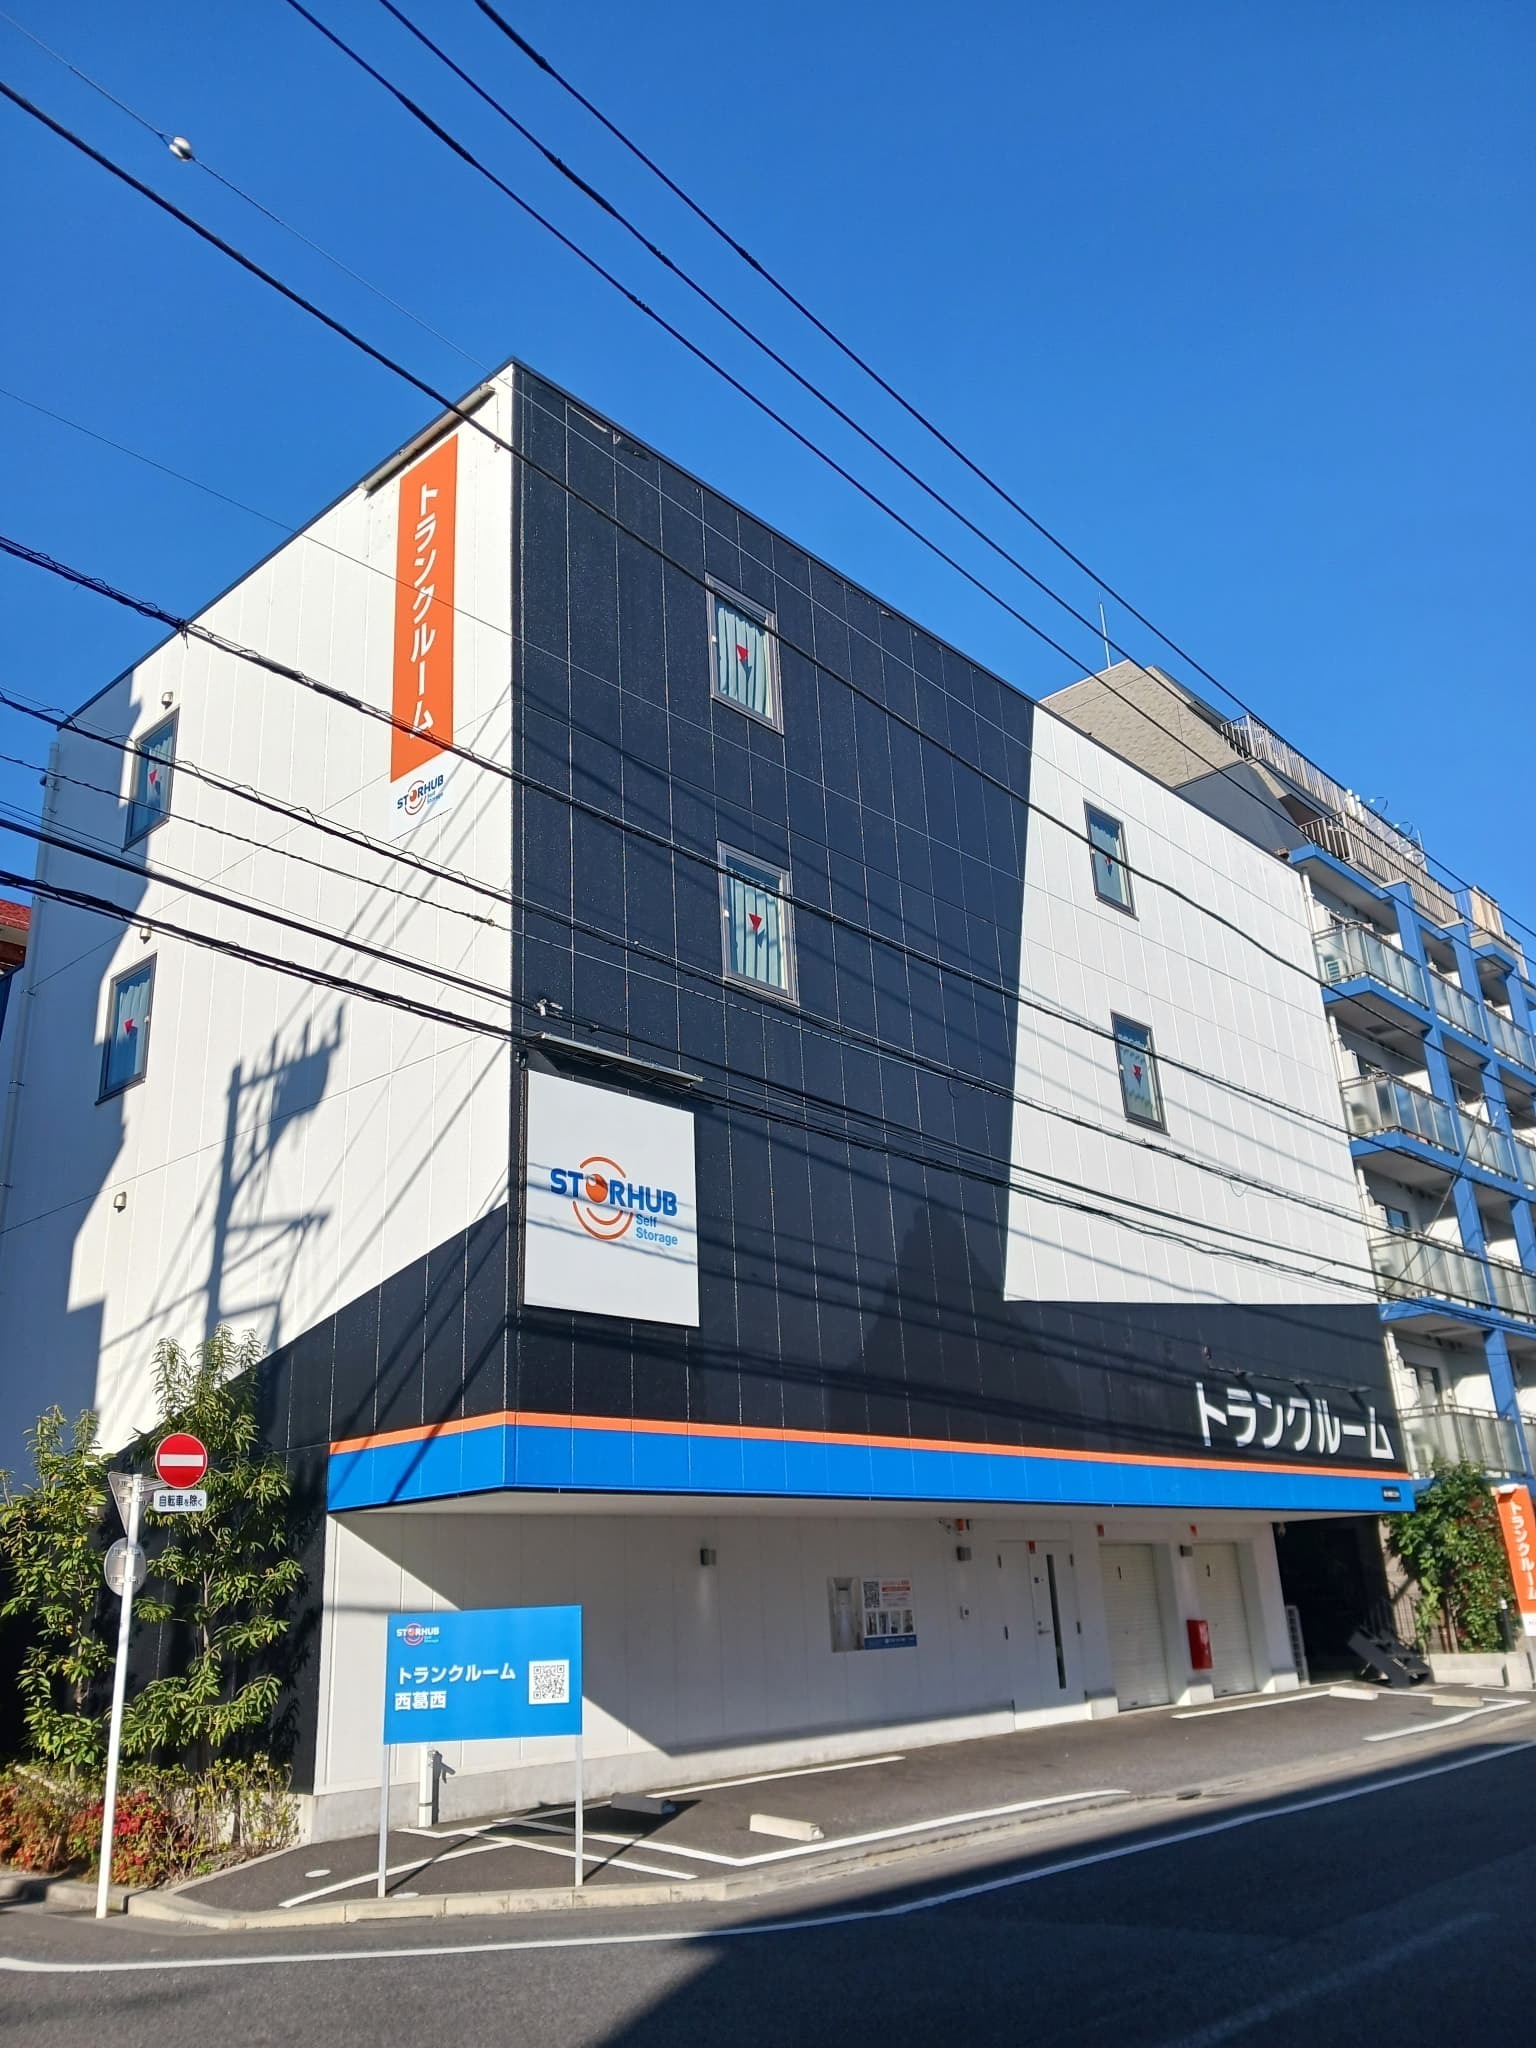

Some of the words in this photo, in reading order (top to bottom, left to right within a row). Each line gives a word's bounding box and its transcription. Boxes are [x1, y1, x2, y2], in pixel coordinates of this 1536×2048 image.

[409, 483, 439, 739] トランクルーム
[550, 1167, 678, 1216] STORHUB
[636, 1213, 657, 1228] Self
[636, 1227, 678, 1246] Storage
[1196, 1382, 1395, 1460] トランクルーム
[159, 1494, 203, 1507] 自転車を除く
[399, 1663, 516, 1685] トランクルーム
[395, 1690, 447, 1711] 西葛西
